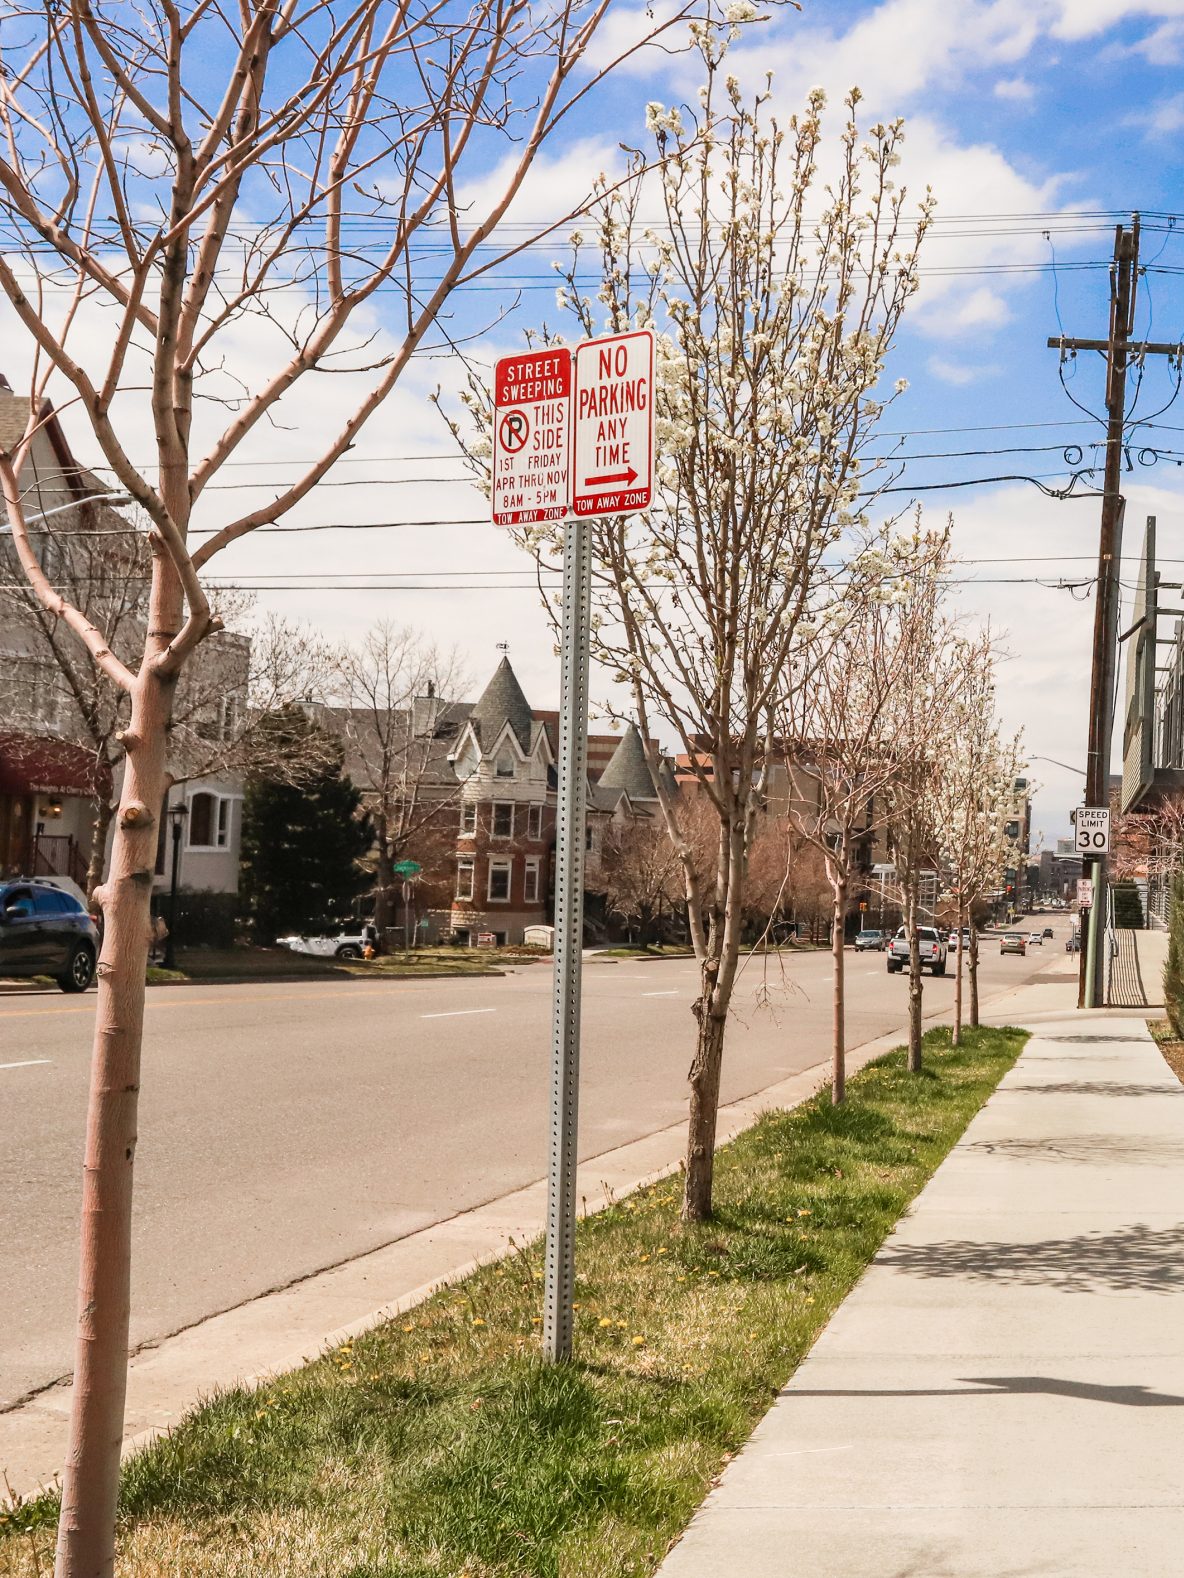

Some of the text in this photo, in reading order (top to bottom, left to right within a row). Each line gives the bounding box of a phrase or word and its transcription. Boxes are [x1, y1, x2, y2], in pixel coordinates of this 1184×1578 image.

[507, 359, 560, 382] STREET
[599, 345, 627, 380] NO
[503, 378, 563, 401] SWEEPING
[580, 378, 646, 420] PARKING
[534, 403, 563, 426] THIS
[533, 428, 563, 451] SIDE
[597, 417, 628, 442] ANY
[500, 452, 561, 472] 1ST FRIDAY
[595, 443, 630, 468] TIME
[496, 470, 566, 491] APR THRU NOV
[503, 495, 523, 508] 8AM
[536, 490, 556, 504] 5PM
[577, 491, 648, 511] TOW AWAY ZONE
[497, 508, 563, 524] TOW AWAY ZONE
[1079, 811, 1108, 819] SPEED
[1079, 831, 1105, 848] 30
